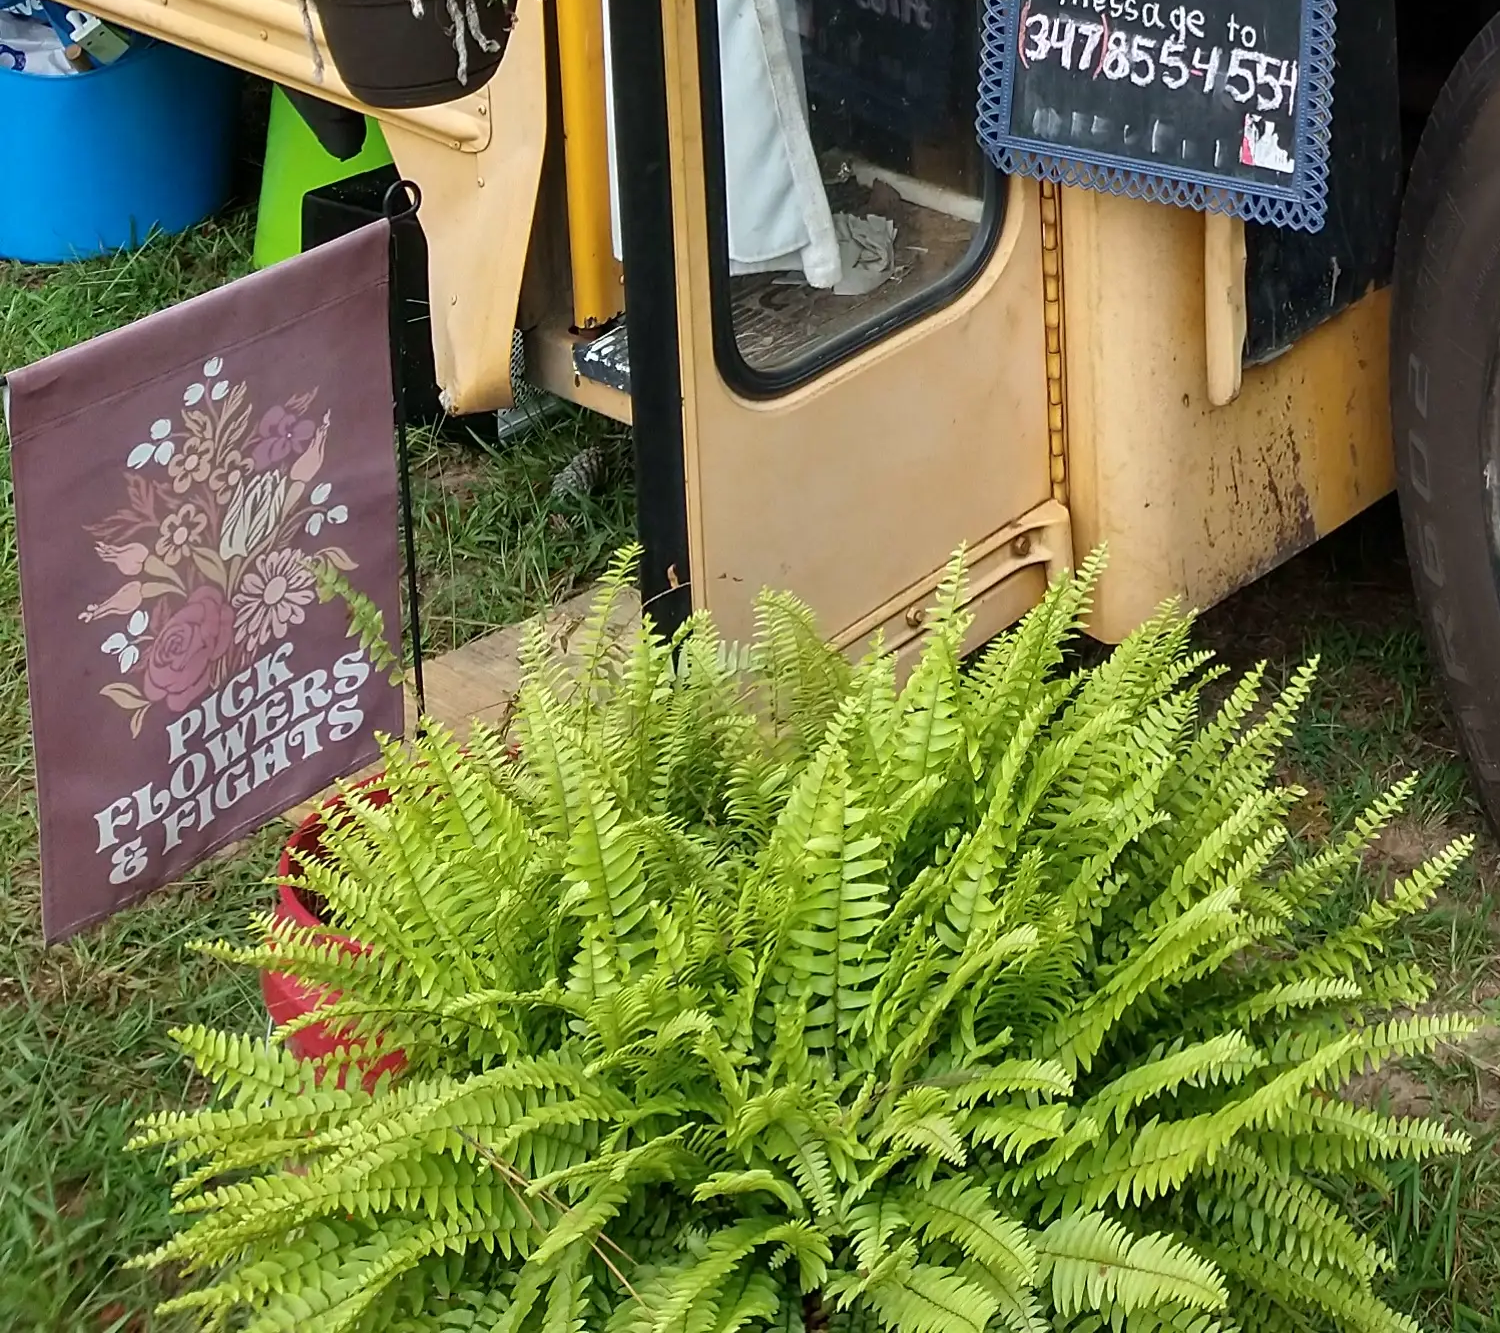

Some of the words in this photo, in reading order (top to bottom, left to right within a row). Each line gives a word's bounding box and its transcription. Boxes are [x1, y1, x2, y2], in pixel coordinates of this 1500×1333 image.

[1227, 13, 1258, 48] to
[94, 648, 370, 853] FLOWERS
[166, 641, 295, 764] PICK
[108, 837, 149, 885] &
[162, 694, 364, 853] FIGHTS
